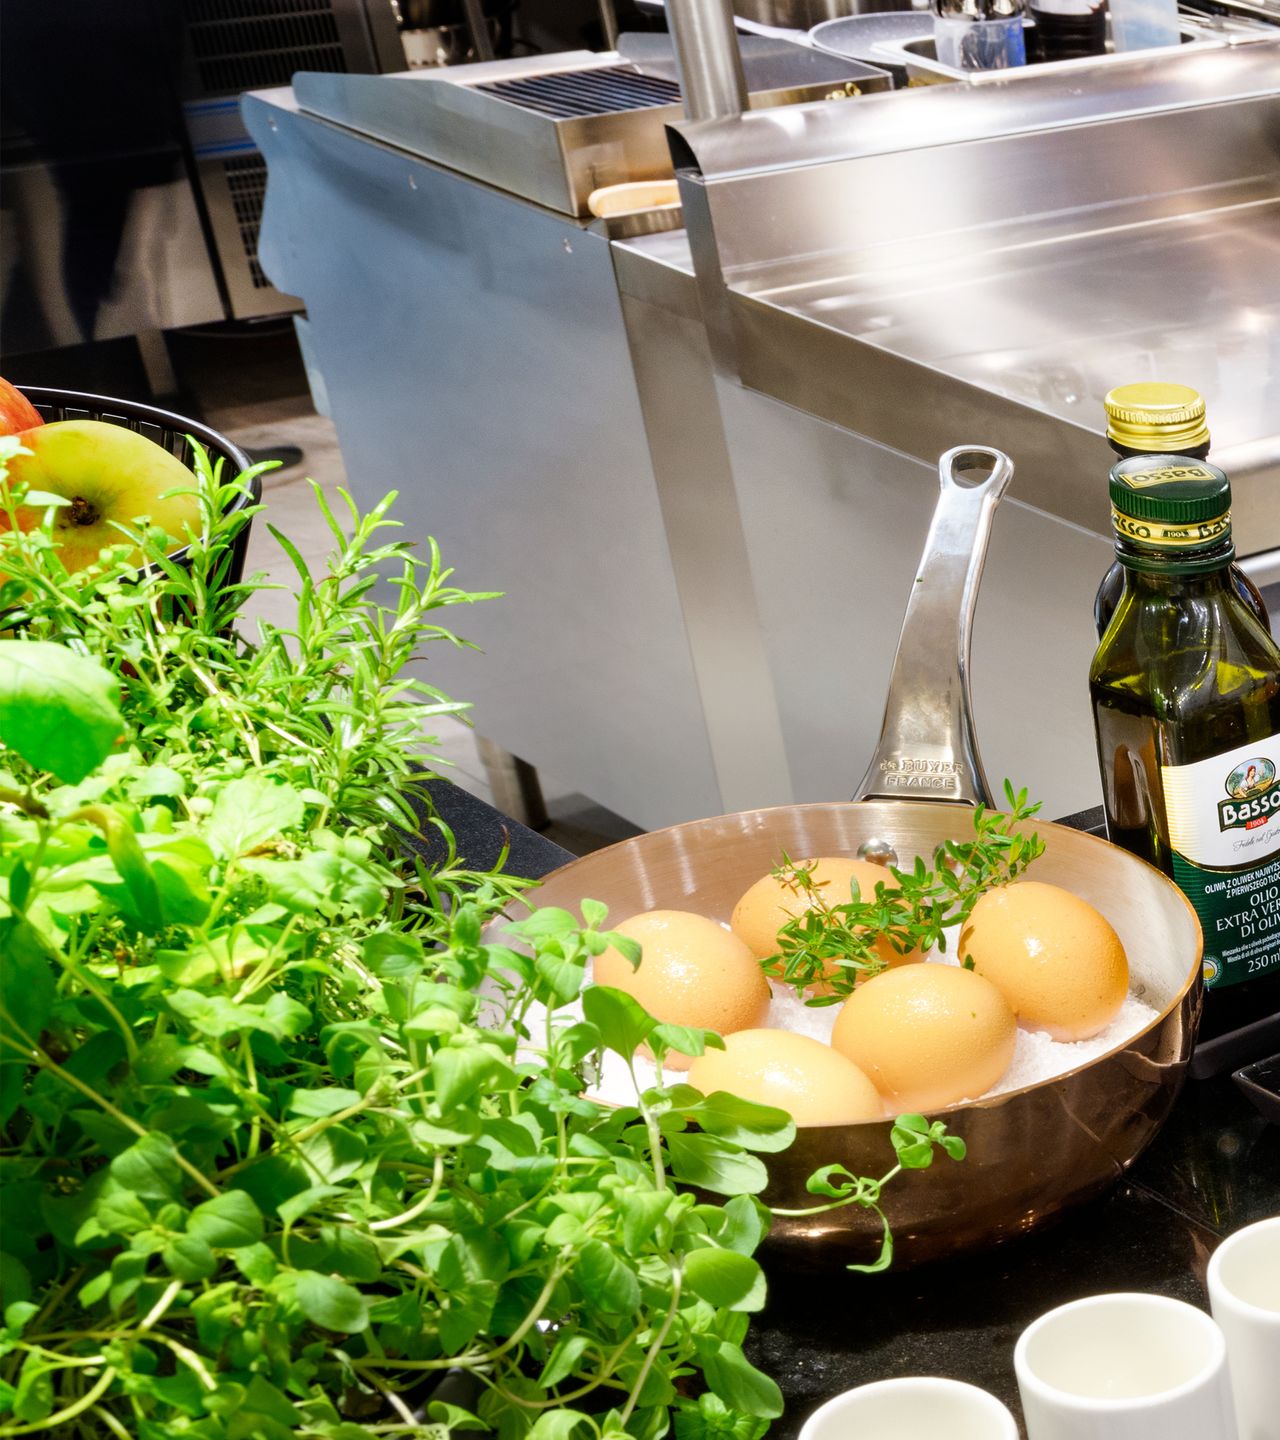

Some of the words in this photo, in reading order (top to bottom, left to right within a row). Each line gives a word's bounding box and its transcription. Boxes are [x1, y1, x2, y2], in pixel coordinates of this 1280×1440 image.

[1205, 881, 1227, 894] OLIWA
[1227, 879, 1232, 889] Z
[1232, 871, 1255, 886] OLIWEK
[1226, 890, 1232, 899] Z
[1231, 877, 1268, 897] PIERWSZEGO
[1250, 886, 1279, 907] OLIO
[1216, 909, 1259, 932] EXTRA
[1240, 923, 1255, 938] DI
[1248, 955, 1270, 973] 250
